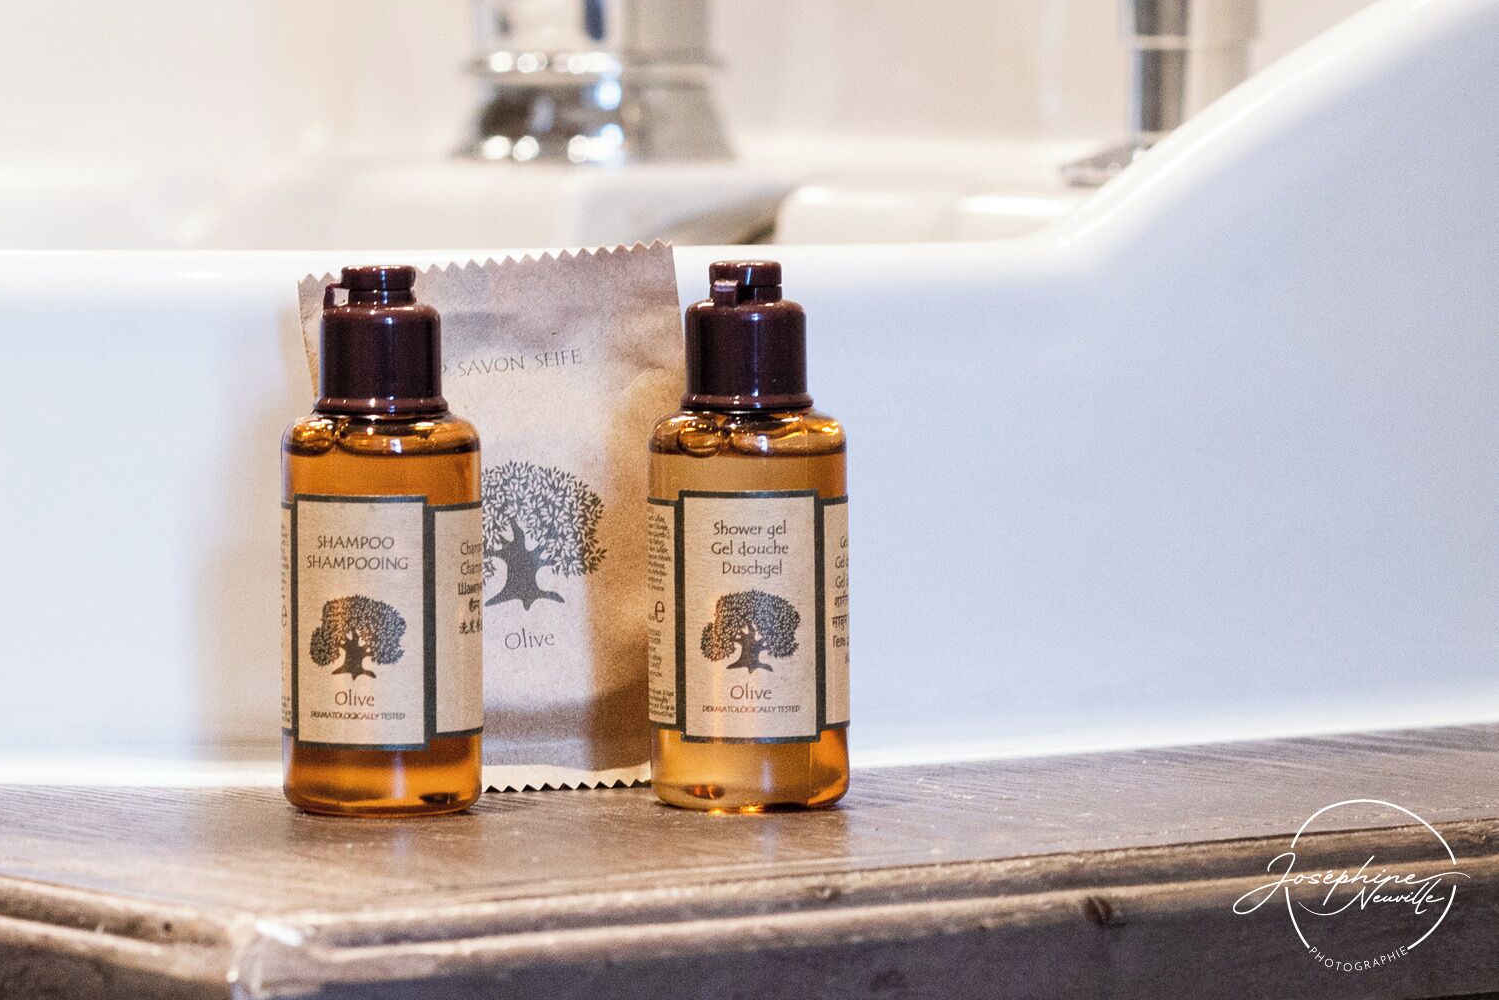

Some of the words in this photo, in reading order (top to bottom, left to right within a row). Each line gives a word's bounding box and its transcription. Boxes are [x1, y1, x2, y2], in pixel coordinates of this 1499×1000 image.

[457, 355, 525, 378] SAVON
[535, 349, 582, 369] SEIFE
[713, 519, 763, 536] Shower
[767, 520, 787, 540] gel
[317, 535, 395, 550] SHAMPOO
[711, 539, 734, 556] Gel
[737, 540, 789, 556] douche
[306, 555, 409, 571] SHAMPOOING
[722, 559, 783, 578] Duschgel
[504, 628, 555, 650] Olive
[334, 688, 375, 707] Olive
[730, 682, 772, 700] Olive
[381, 711, 406, 721] TESTED
[702, 704, 776, 713] DERMATOLOGICALLY
[778, 704, 801, 713] TESTED
